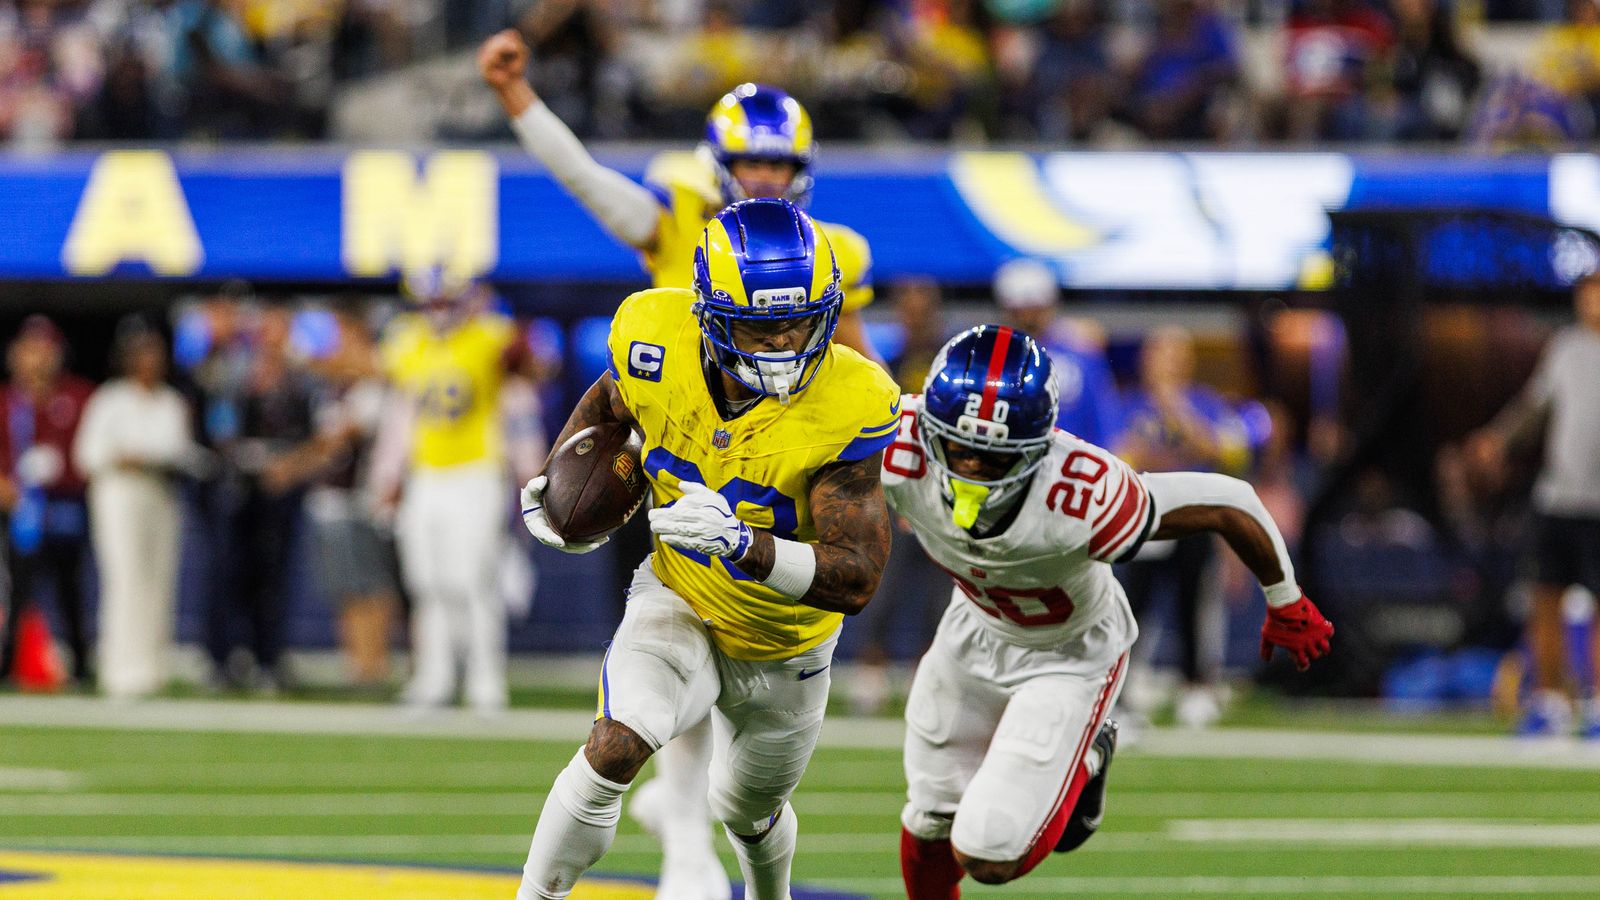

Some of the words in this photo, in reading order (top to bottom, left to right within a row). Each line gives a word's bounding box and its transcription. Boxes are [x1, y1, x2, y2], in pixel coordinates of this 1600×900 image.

[631, 344, 661, 372] C
[964, 393, 1010, 424] 20
[1046, 450, 1108, 520] 20
